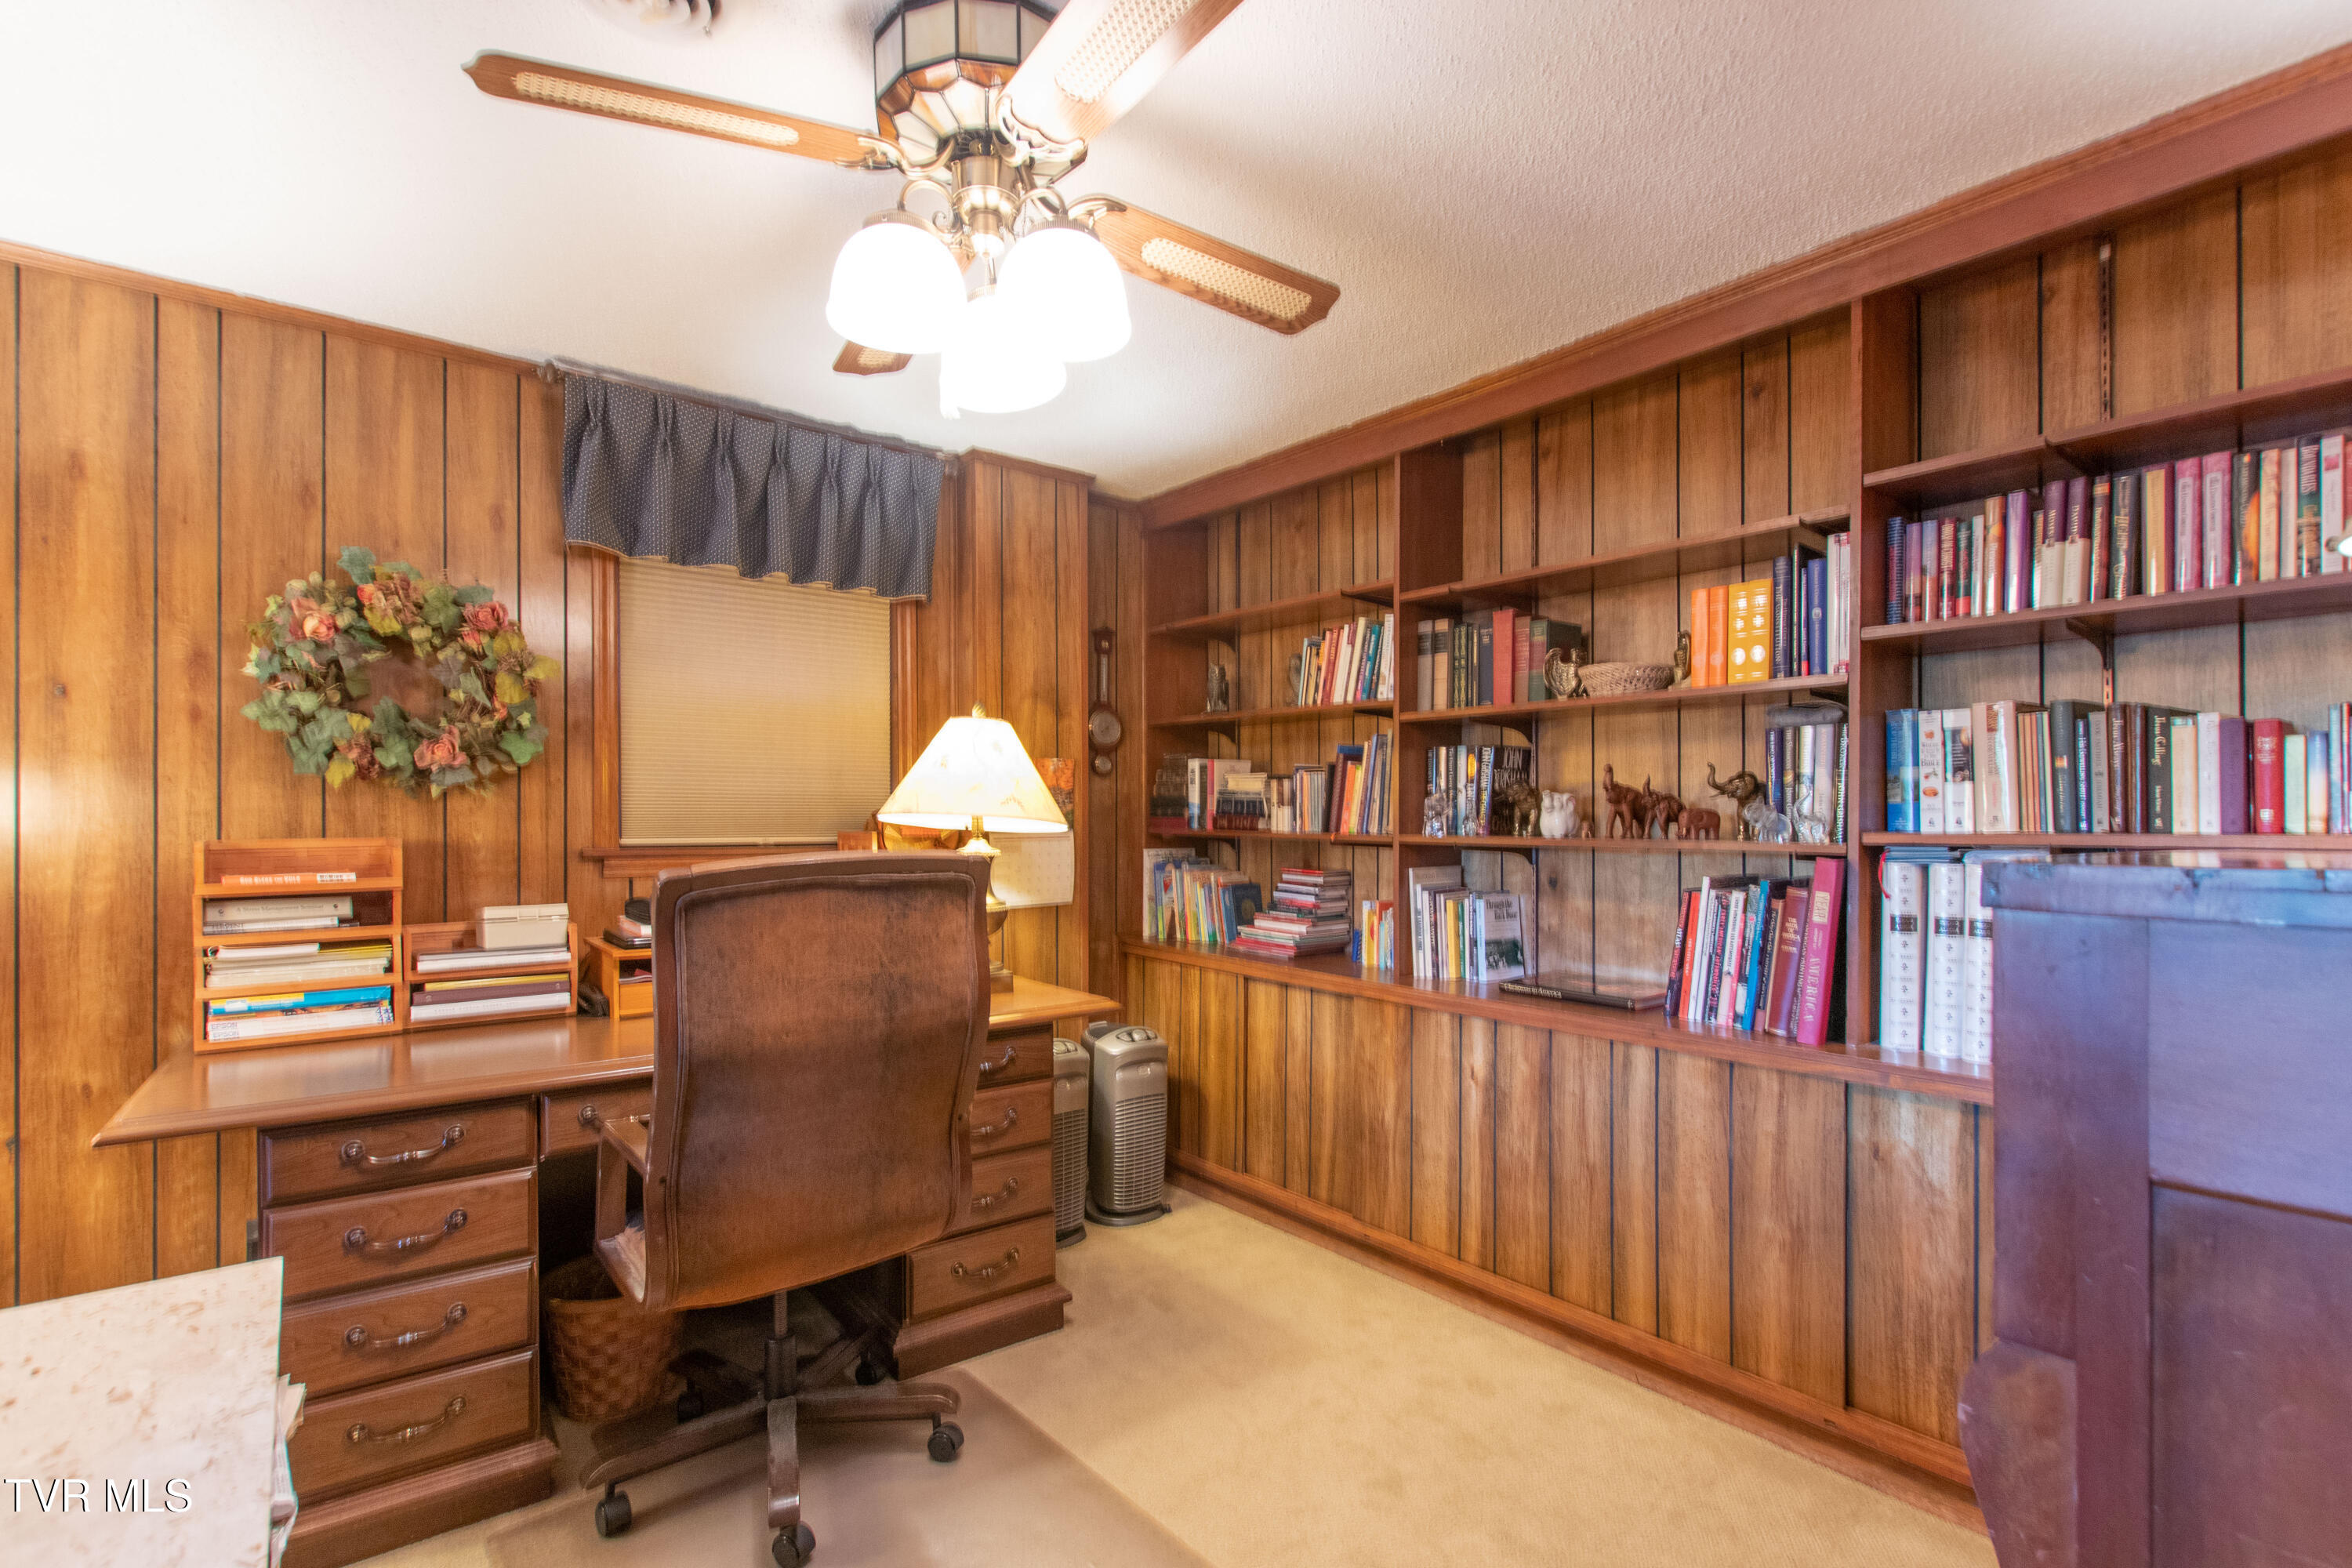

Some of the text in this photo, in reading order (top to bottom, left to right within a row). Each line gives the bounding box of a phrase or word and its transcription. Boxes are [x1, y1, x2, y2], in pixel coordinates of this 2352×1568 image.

[2151, 716, 2166, 767] Jesus Calling
[1482, 746, 1491, 762] JOHN
[1479, 762, 1490, 788] GRISHAM
[1835, 805, 1844, 842] GRISHAM
[1486, 899, 1504, 909] Through
[1505, 910, 1518, 919] Door
[1813, 894, 1829, 922] YEAR
[1675, 927, 1683, 948] ATLAS
[1537, 986, 1563, 999] America
[1804, 956, 1820, 1022] AMERICA
